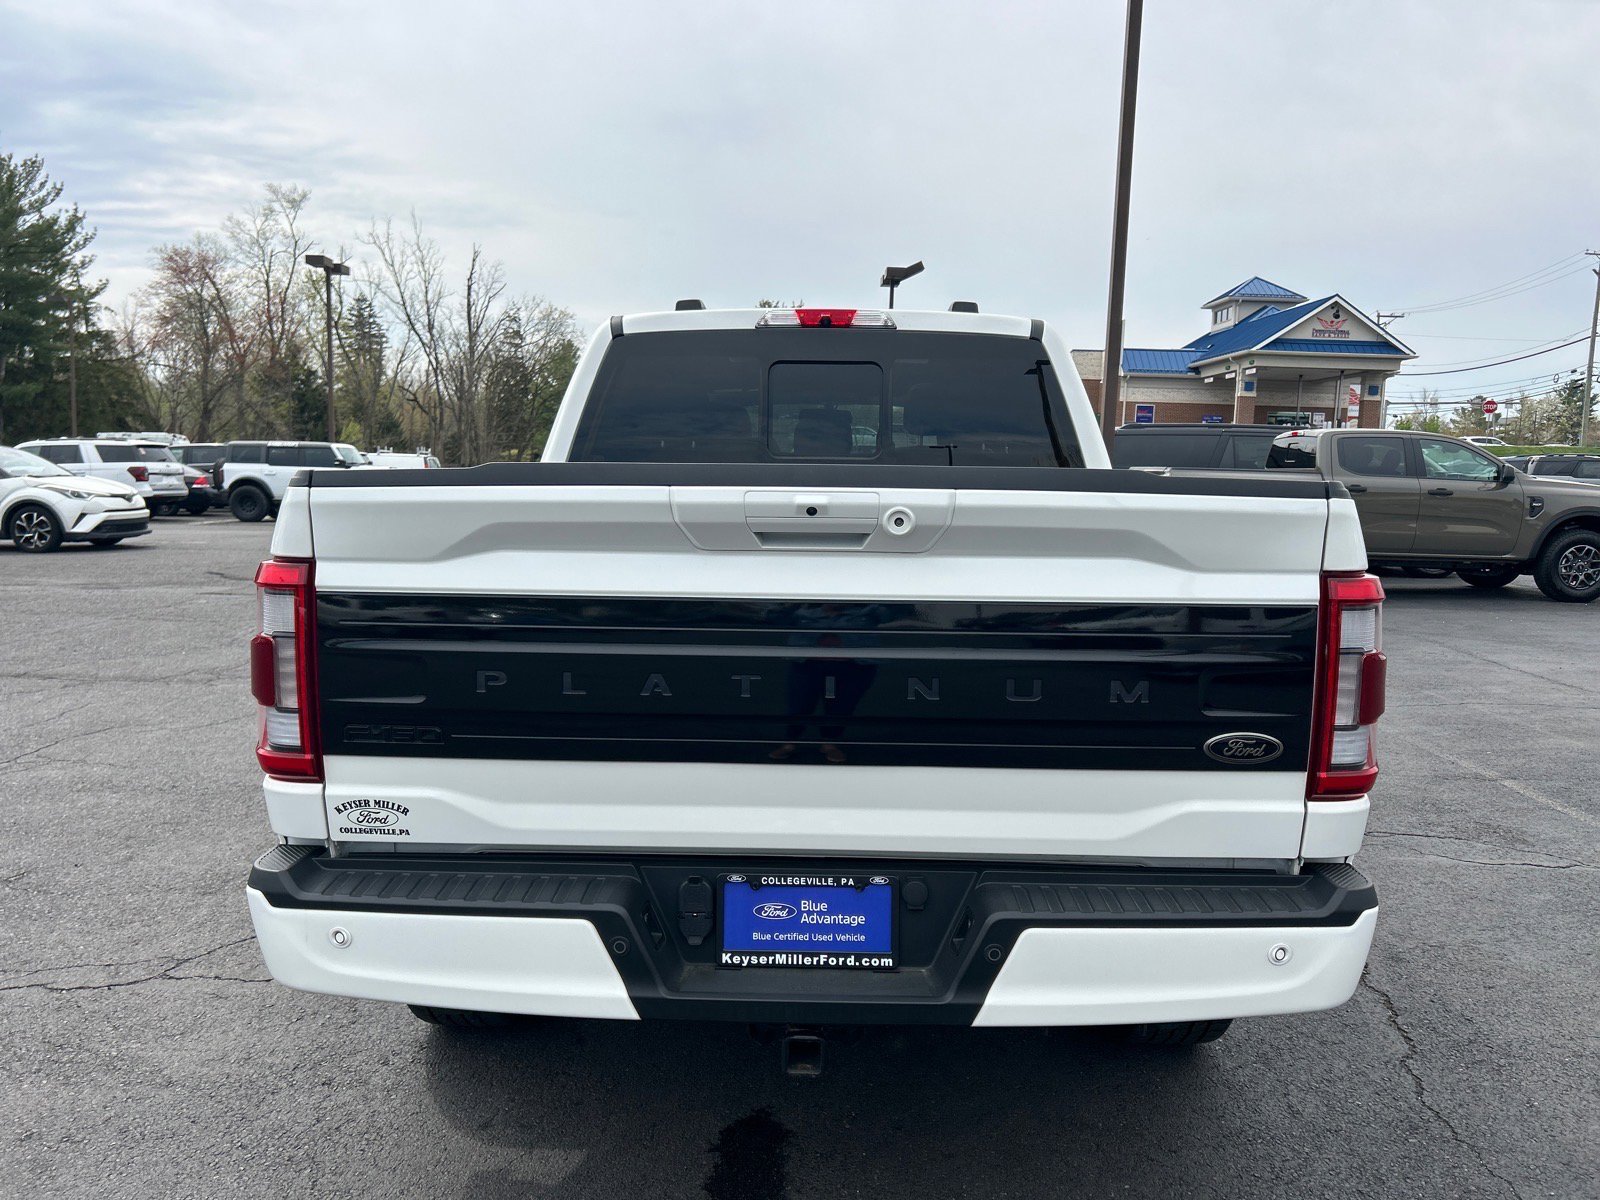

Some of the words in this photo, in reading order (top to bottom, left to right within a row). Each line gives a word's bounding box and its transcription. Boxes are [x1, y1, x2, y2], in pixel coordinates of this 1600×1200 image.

[475, 670, 1150, 704] PLATINUM
[1223, 738, 1267, 757] Ford
[334, 799, 371, 815] KEYSER
[373, 799, 410, 816] MILLER
[356, 809, 390, 825] Ford
[761, 876, 837, 886] COLLEGEVILLE,
[841, 877, 855, 886] PA
[761, 904, 789, 918] Ford
[801, 900, 828, 912] Blue
[800, 913, 866, 927] Advantage
[752, 932, 772, 941] Blue
[773, 932, 809, 942] Certified
[811, 933, 833, 942] Used
[835, 933, 866, 942] Vehicle
[721, 953, 893, 967] KeyserMillerFord.com
